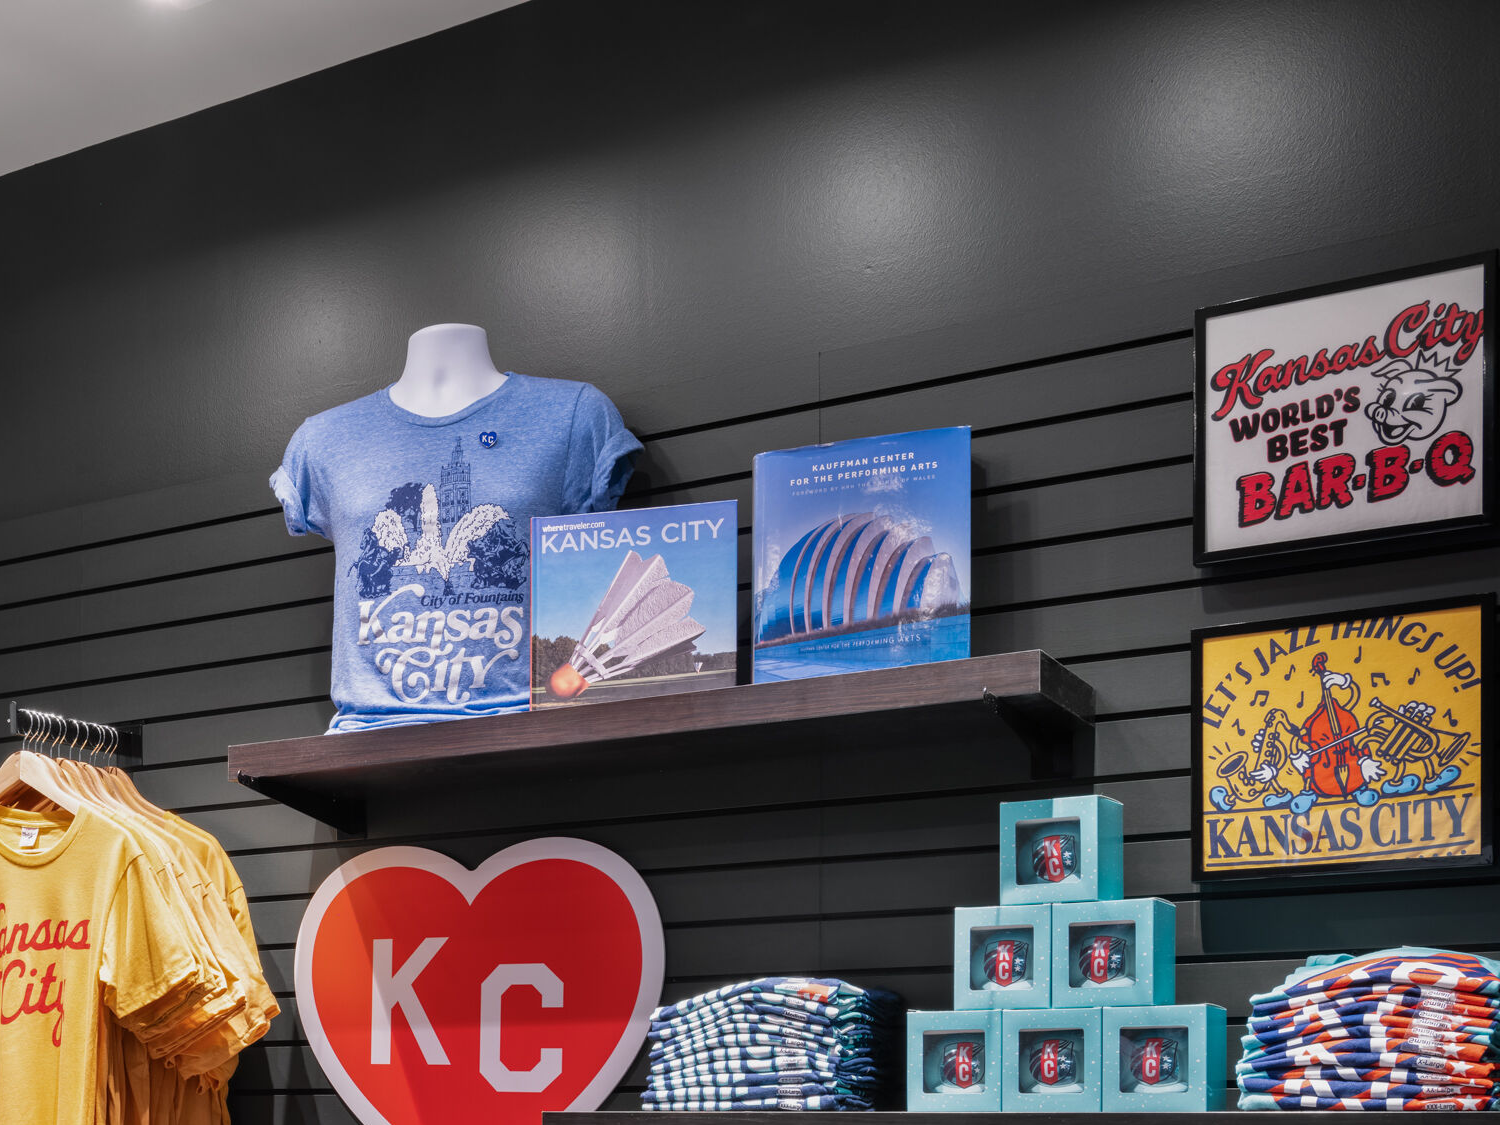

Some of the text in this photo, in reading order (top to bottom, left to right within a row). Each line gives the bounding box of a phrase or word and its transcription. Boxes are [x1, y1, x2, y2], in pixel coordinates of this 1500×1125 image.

[1210, 300, 1484, 421] Kansas City
[1229, 386, 1361, 443] WORLD'S
[482, 434, 495, 445] KC
[1267, 418, 1348, 463] BEST
[790, 461, 938, 487] FOR THE PERFORMING ARTS
[812, 452, 915, 472] KAUFFMAN CENTER
[1236, 430, 1476, 528] BAR-B-Q
[541, 518, 724, 554] KANSAS CITY
[542, 521, 605, 533] wheretraveler.com
[357, 584, 524, 653] Kansas
[421, 590, 525, 609] City of Fountains
[852, 636, 895, 648] PERFORMING
[375, 642, 519, 703] City
[1202, 661, 1253, 729] LET'S
[1253, 625, 1322, 677] JAZZ
[1433, 643, 1482, 694] UP!
[1206, 793, 1473, 860] KANSAS CITY
[1045, 839, 1061, 876] KC
[998, 943, 1011, 981] KC
[1093, 940, 1109, 977] KC
[0, 959, 66, 1047] City
[370, 936, 565, 1093] KC
[957, 1045, 970, 1081] KC
[1043, 1040, 1056, 1078] KC
[1146, 1040, 1160, 1078] KC
[1418, 1060, 1445, 1069] X-Large
